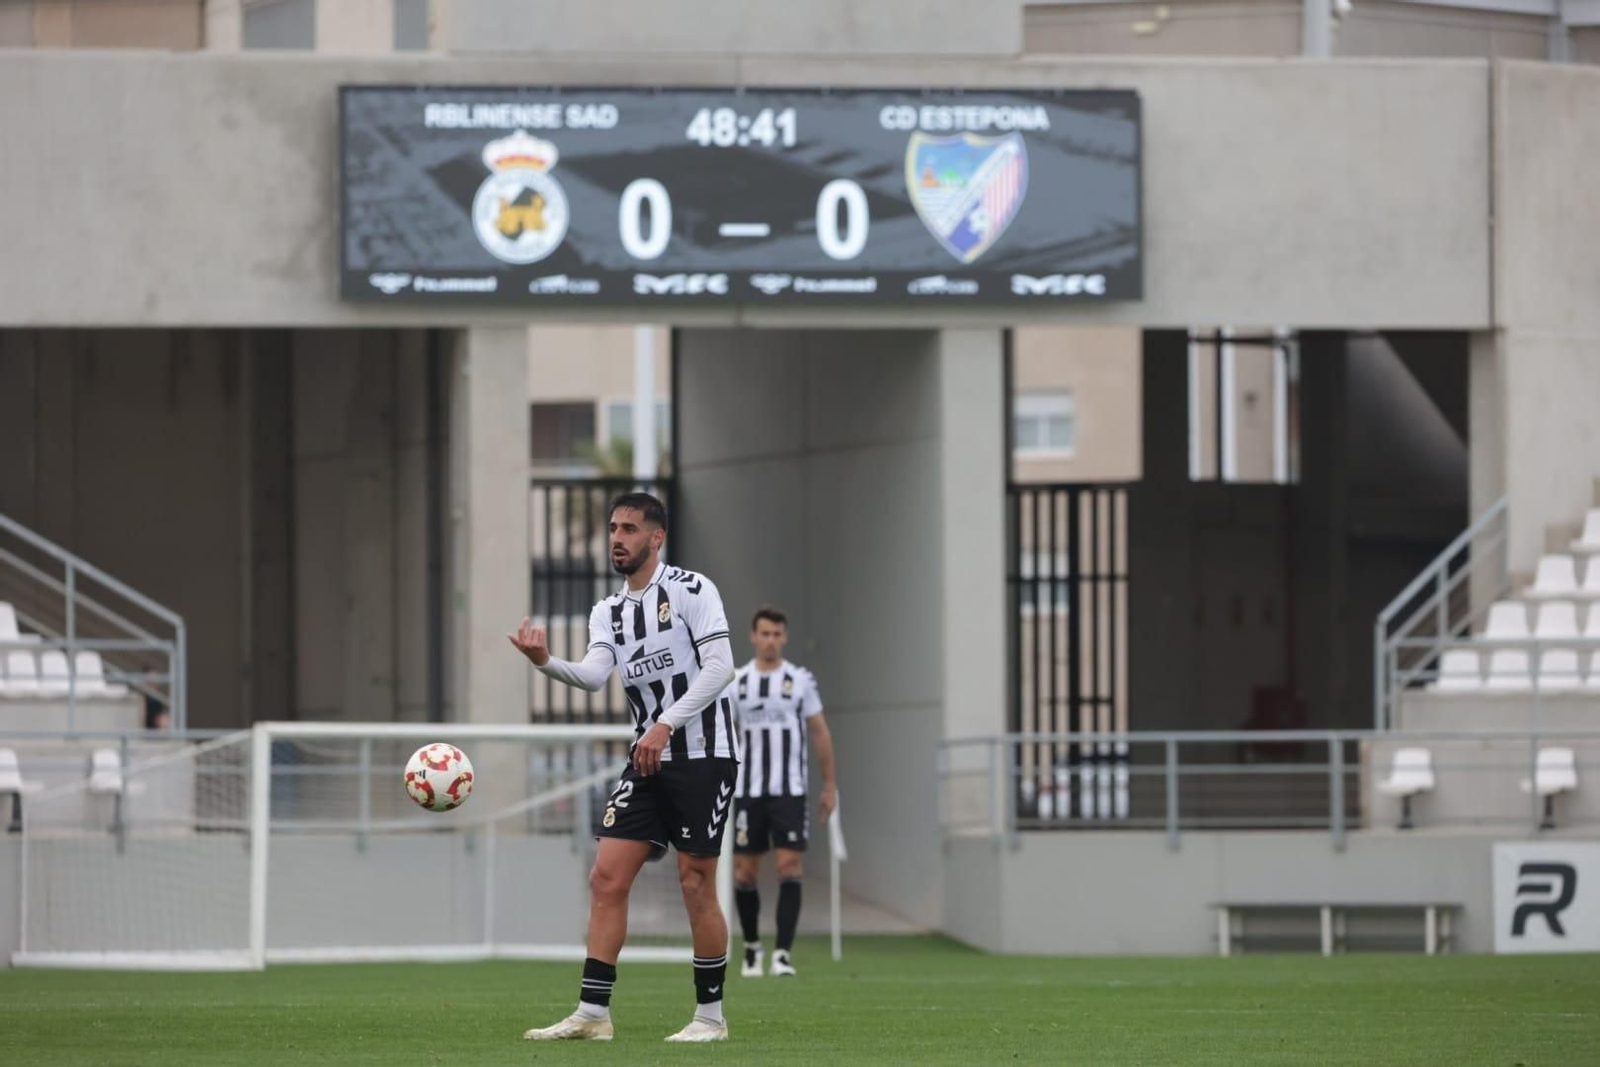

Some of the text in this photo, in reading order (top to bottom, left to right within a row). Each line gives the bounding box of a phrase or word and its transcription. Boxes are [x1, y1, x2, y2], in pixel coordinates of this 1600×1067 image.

[423, 103, 620, 129] RBLINENSE SAD
[685, 107, 798, 148] 48:41
[878, 105, 1050, 131] CD ESTEPONA
[618, 177, 672, 260] 0
[815, 178, 870, 261] 0
[626, 652, 674, 679] LOTUS
